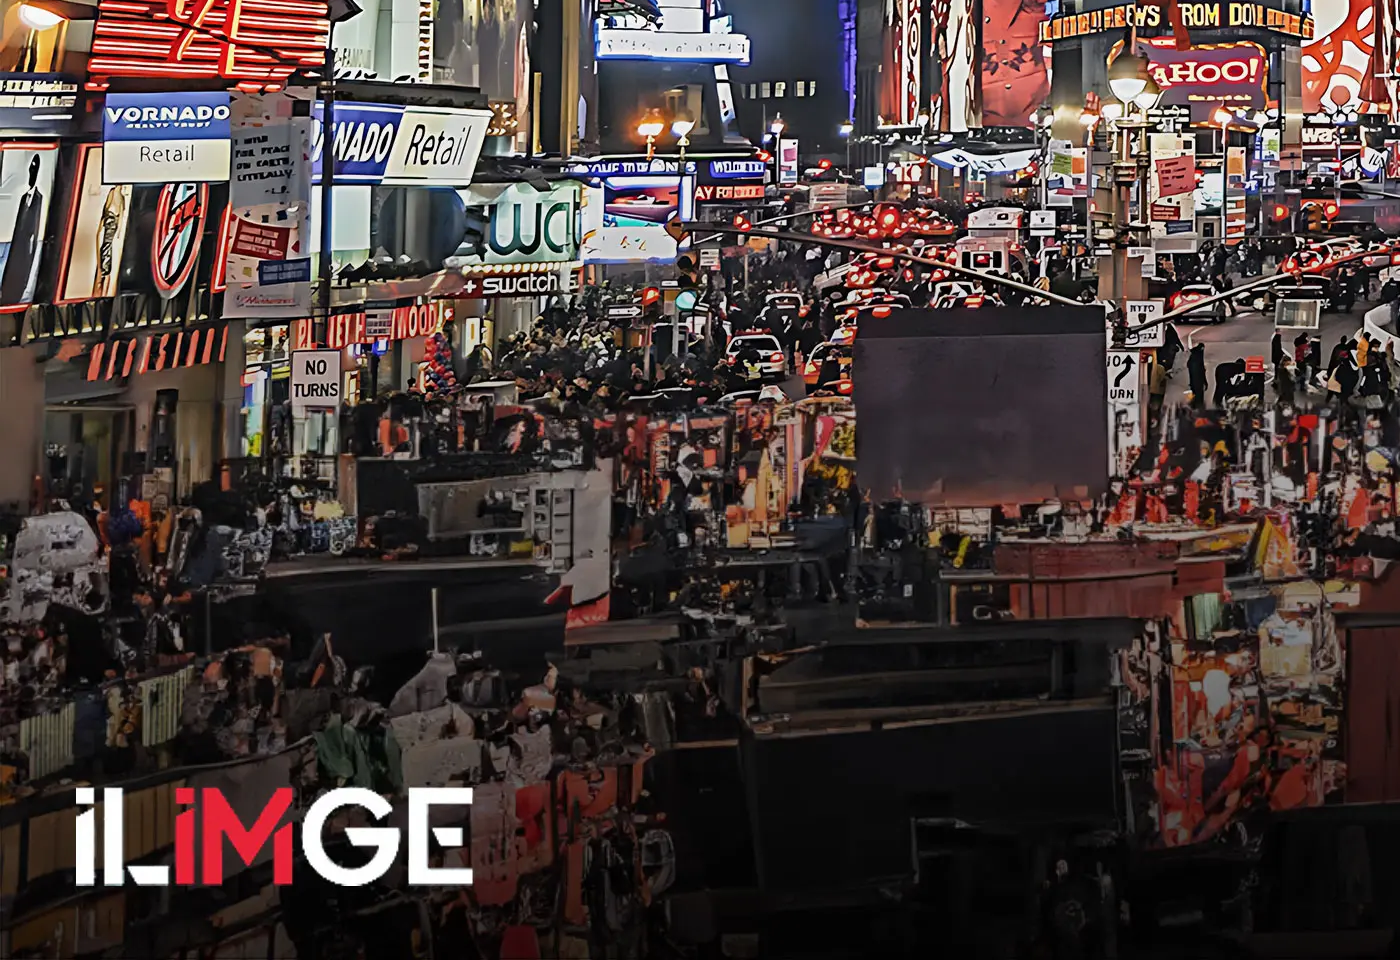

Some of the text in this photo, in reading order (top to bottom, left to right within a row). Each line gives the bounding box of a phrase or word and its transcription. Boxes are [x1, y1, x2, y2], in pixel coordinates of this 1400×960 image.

[105, 105, 231, 125] VORNADO
[139, 144, 195, 163] Retail
[404, 123, 473, 168] Retail
[482, 271, 557, 295] swatch
[305, 359, 328, 375] NO
[293, 382, 339, 398] TURNS
[1109, 388, 1135, 399] URN
